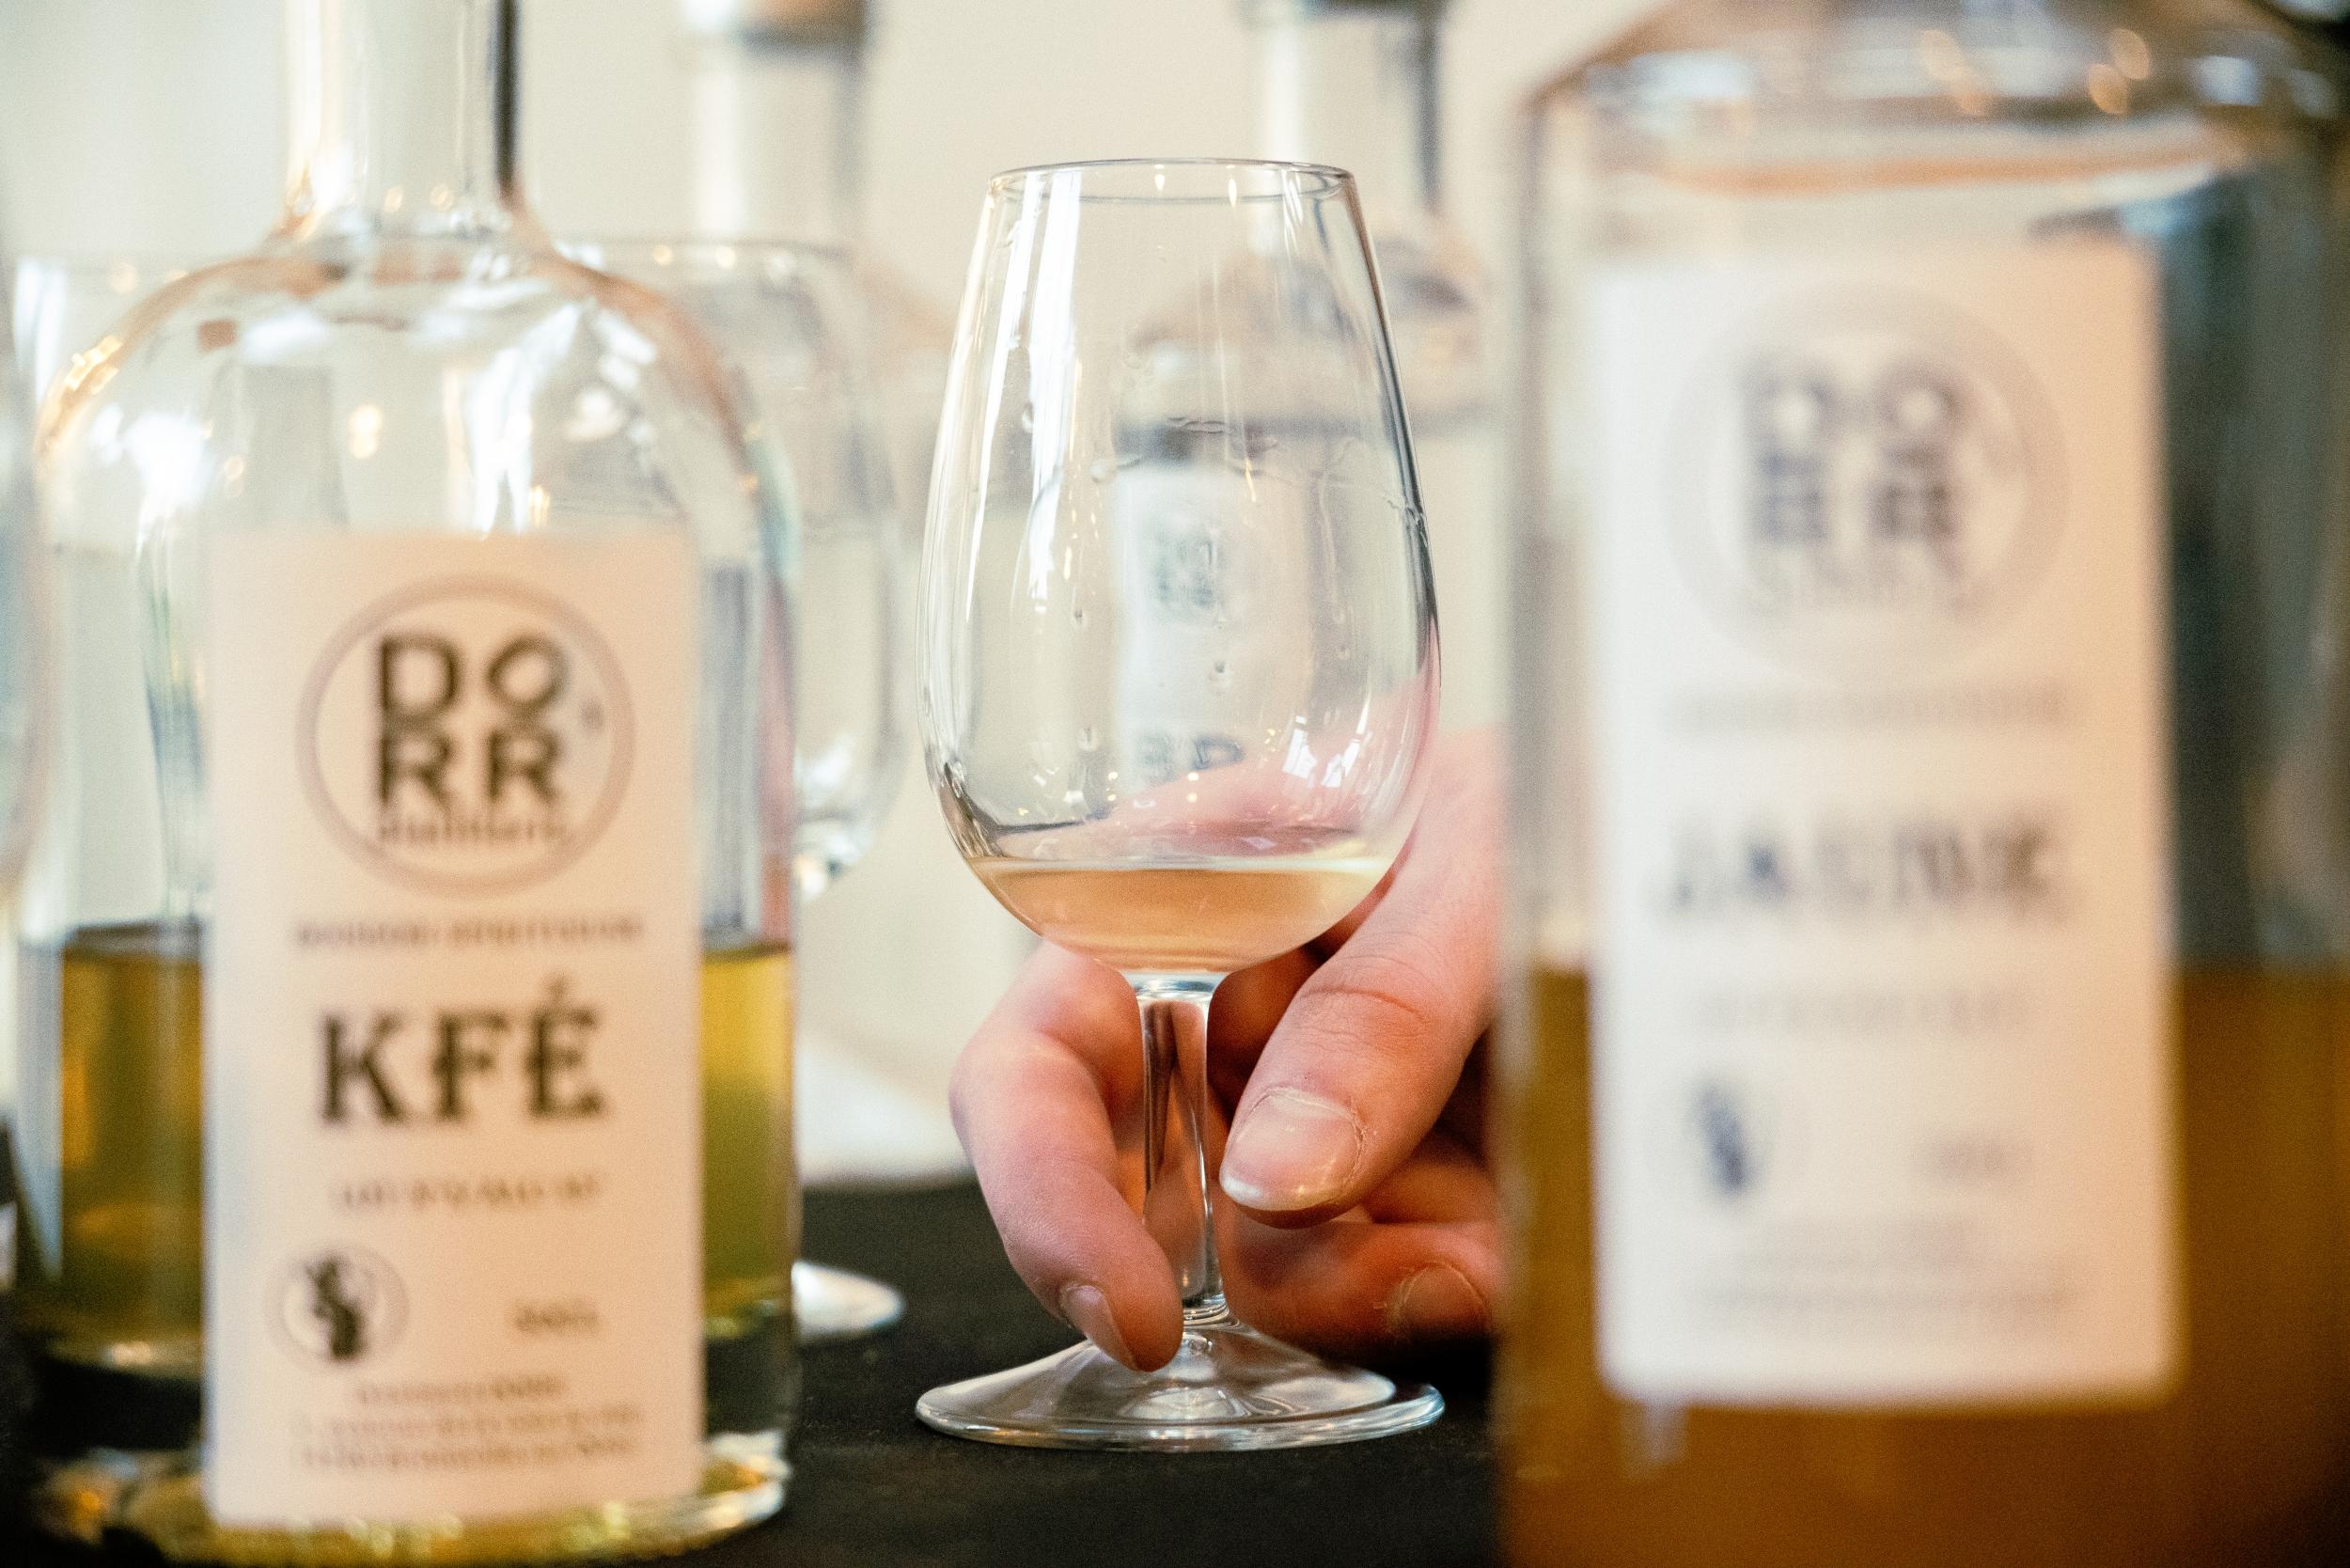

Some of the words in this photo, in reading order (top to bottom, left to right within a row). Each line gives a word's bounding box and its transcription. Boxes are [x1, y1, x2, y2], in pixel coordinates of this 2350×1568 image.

[377, 633, 568, 717] DO
[377, 725, 562, 808] RR
[320, 974, 606, 1126] KFÉ
